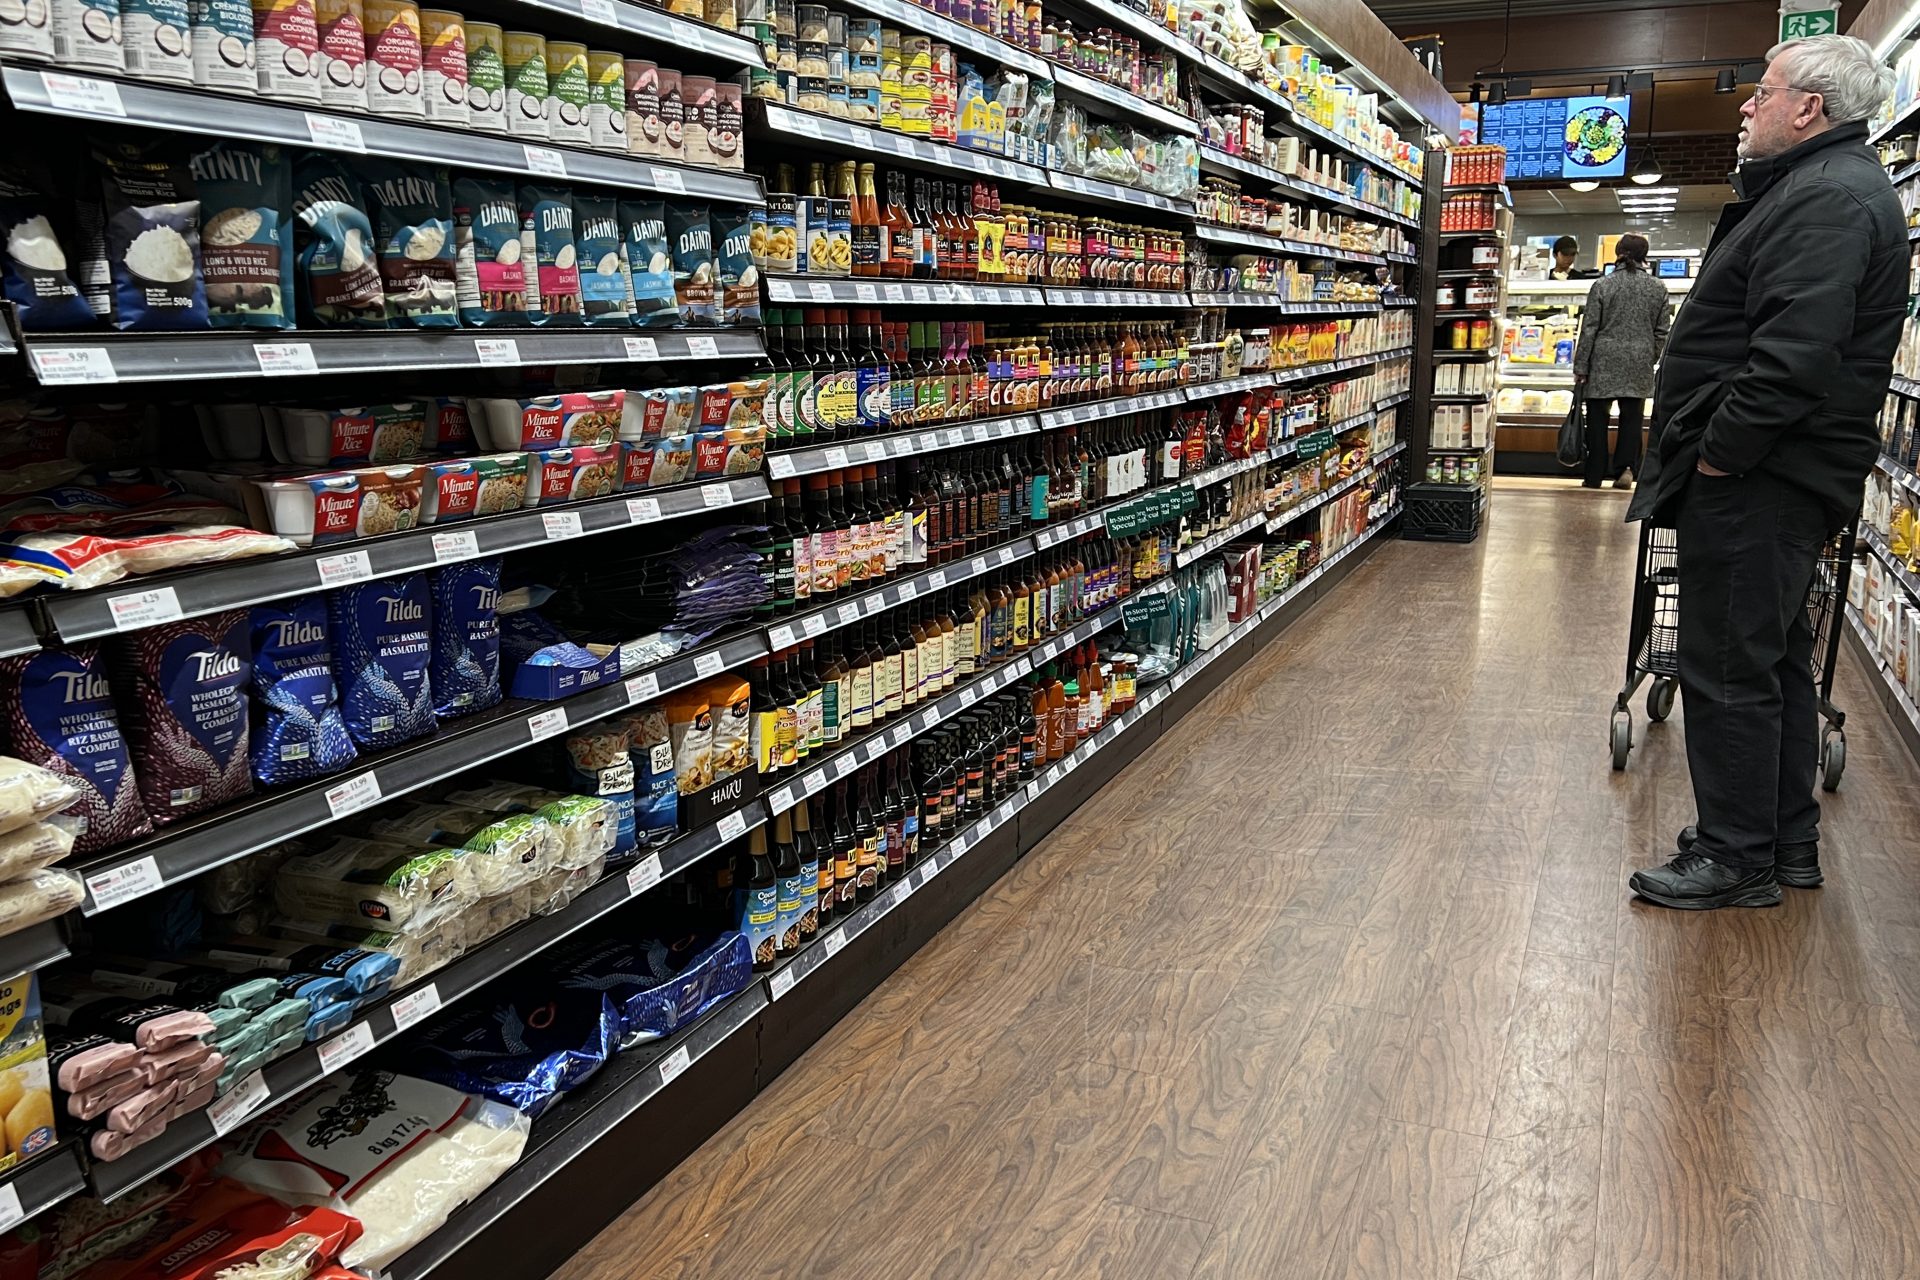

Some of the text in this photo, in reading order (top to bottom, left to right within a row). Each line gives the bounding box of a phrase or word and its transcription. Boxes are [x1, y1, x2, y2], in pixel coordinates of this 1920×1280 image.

[385, 37, 416, 48] ORGANIC
[188, 149, 263, 187] AiNTY
[480, 200, 517, 228] DAiNT
[543, 206, 572, 233] DAiNT
[680, 231, 712, 254] DAiNT
[724, 236, 751, 258] DAiN
[205, 256, 267, 266] LONG & WILD RICE
[213, 266, 238, 277] LONGS
[238, 266, 248, 276] ET
[248, 266, 259, 276] RIZ
[173, 297, 192, 308] 500g
[68, 352, 89, 362] 9.99
[704, 395, 728, 408] Minute
[443, 411, 468, 425] Minu
[526, 413, 559, 427] Minute
[707, 408, 723, 419] Rice
[335, 422, 370, 438] Minute
[532, 426, 553, 438] Rice
[341, 437, 363, 451] Rice
[699, 444, 725, 457] Minute
[627, 453, 651, 467] Minute
[704, 456, 719, 467] Rice
[544, 466, 571, 481] Minute
[631, 467, 645, 478] Rice
[441, 477, 475, 495] Minute
[549, 480, 565, 493] Rice
[318, 496, 355, 514] Minute
[447, 494, 468, 508] Rice
[325, 511, 348, 527] Rice
[1109, 512, 1135, 524] In-Store
[1111, 521, 1136, 531] Special
[851, 541, 871, 551] Teriy
[343, 555, 358, 565] 3.29
[814, 558, 837, 567] Teriy
[469, 585, 496, 610] Til
[376, 596, 423, 623] Tilda
[1125, 608, 1148, 616] In-Store
[467, 620, 490, 630] PURE
[1127, 614, 1149, 623] Special
[264, 619, 325, 648] Tilda
[376, 634, 400, 645] PURE
[380, 643, 417, 657] BASMATI
[185, 650, 241, 682] Tilda
[273, 657, 300, 670] PURE
[579, 669, 601, 686] Tilda
[48, 670, 110, 704] Tilda
[191, 685, 237, 703] WHOLEG
[195, 711, 213, 723] RIZ
[202, 711, 240, 730] COMPLET
[67, 736, 89, 747] RIZ
[78, 740, 120, 755] COMPLET
[655, 748, 670, 760] BLU
[350, 777, 367, 791] 11.99
[651, 780, 667, 791] RICE
[711, 779, 742, 806] HAIKU
[119, 863, 143, 879] 10.99
[367, 1145, 383, 1156] 8
[375, 1137, 400, 1150] kg
[160, 1230, 221, 1267] CONVERTED
